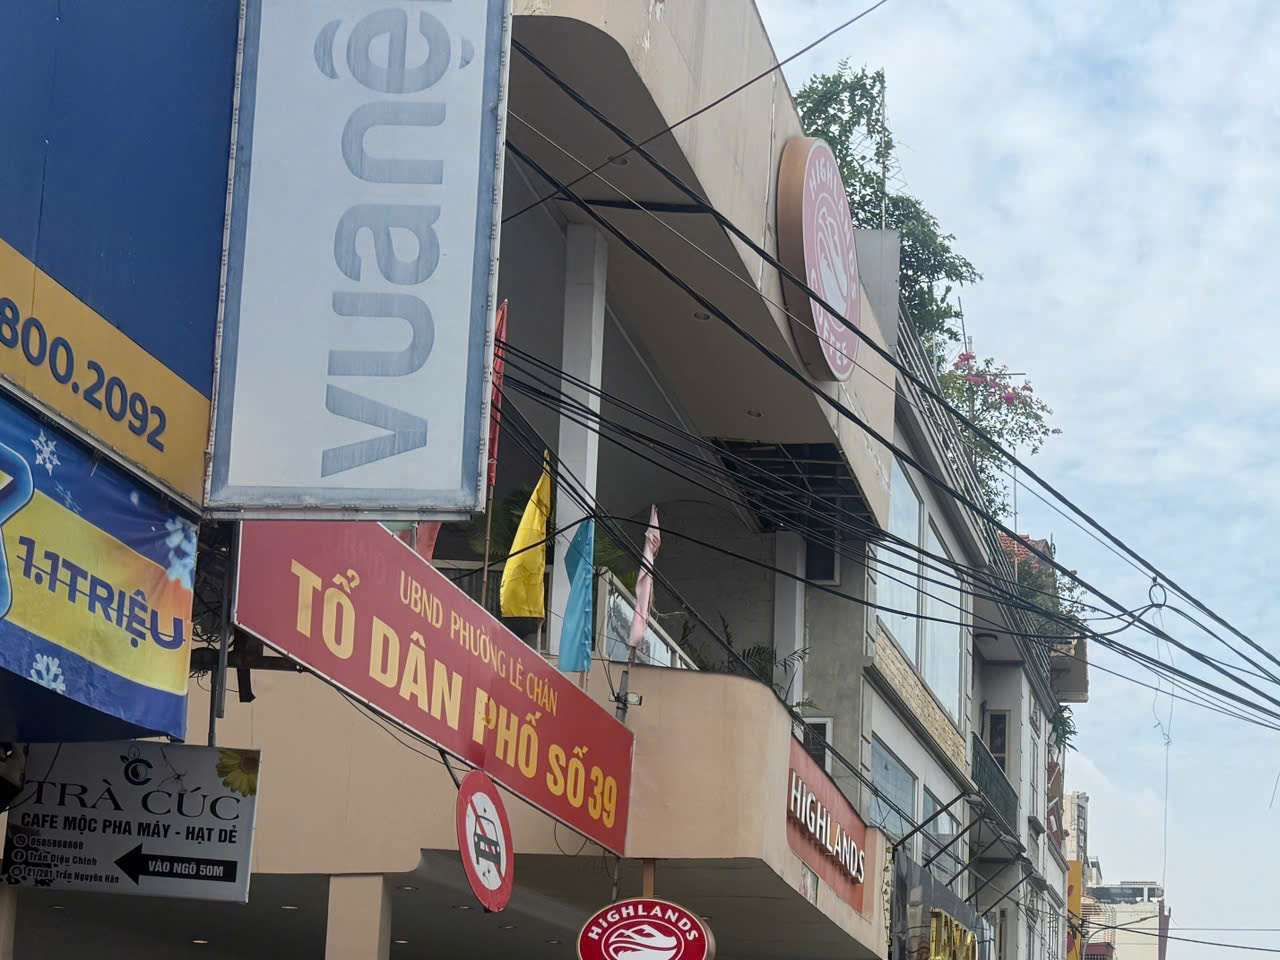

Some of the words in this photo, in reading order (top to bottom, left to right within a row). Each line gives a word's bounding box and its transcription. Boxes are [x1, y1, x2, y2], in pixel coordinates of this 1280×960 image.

[314, 0, 475, 478] vuanệ
[0, 297, 167, 452] 800.2092
[291, 559, 361, 660] TỔ
[369, 616, 463, 730] DÂN
[472, 687, 542, 779] PHỐ
[546, 744, 589, 808] SỐ
[588, 766, 618, 829] 39
[400, 570, 444, 629] UBND
[450, 615, 507, 678] PHƯỜNG
[509, 657, 524, 692] LÊ
[526, 671, 558, 716] CHÂN
[21, 812, 58, 830] CAFE
[63, 814, 97, 835] MỘC
[102, 819, 132, 836] PHA
[137, 821, 171, 838] MÁY
[185, 826, 214, 844] HẠT
[218, 824, 238, 844] DẺ
[25, 778, 124, 812] TRÀ
[141, 786, 241, 821] CÚC
[790, 770, 865, 884] HIGHLANDS
[148, 858, 170, 873] VÀO
[173, 860, 197, 875] NGÕ
[199, 863, 224, 877] 50M
[587, 904, 699, 941] HIGHLANDS
